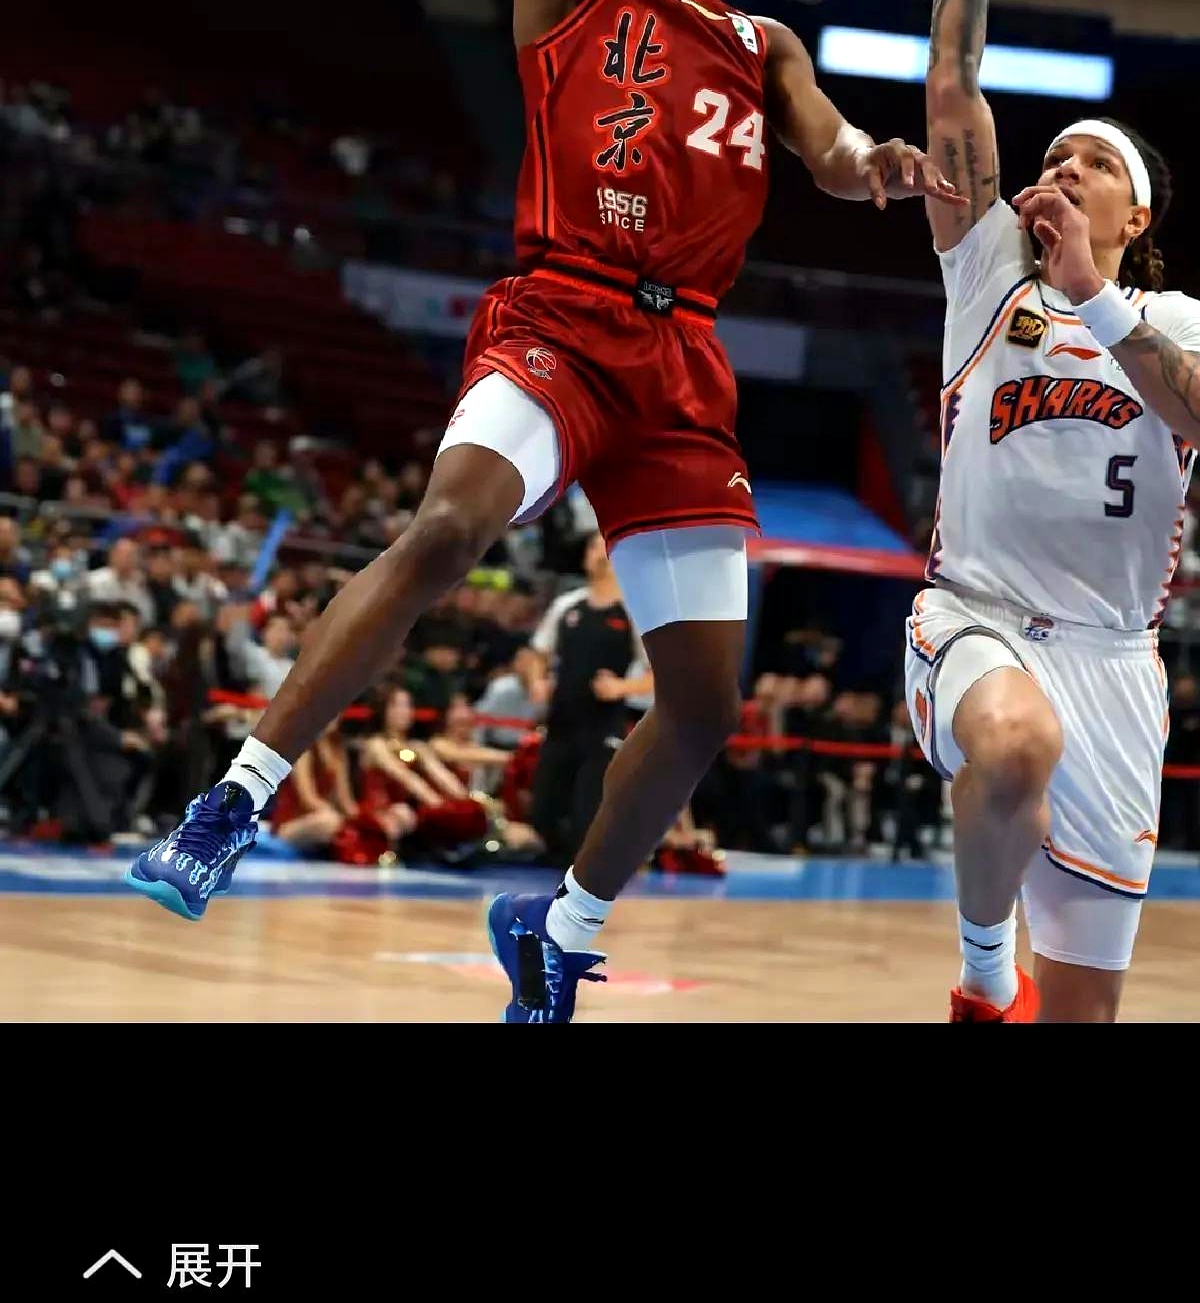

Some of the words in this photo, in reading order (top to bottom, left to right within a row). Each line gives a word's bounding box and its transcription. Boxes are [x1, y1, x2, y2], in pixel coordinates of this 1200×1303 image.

[596, 9, 666, 171] 北京
[686, 88, 767, 171] 24
[596, 186, 648, 217] 1956
[990, 374, 1144, 445] SHARKS
[1104, 455, 1139, 519] 5
